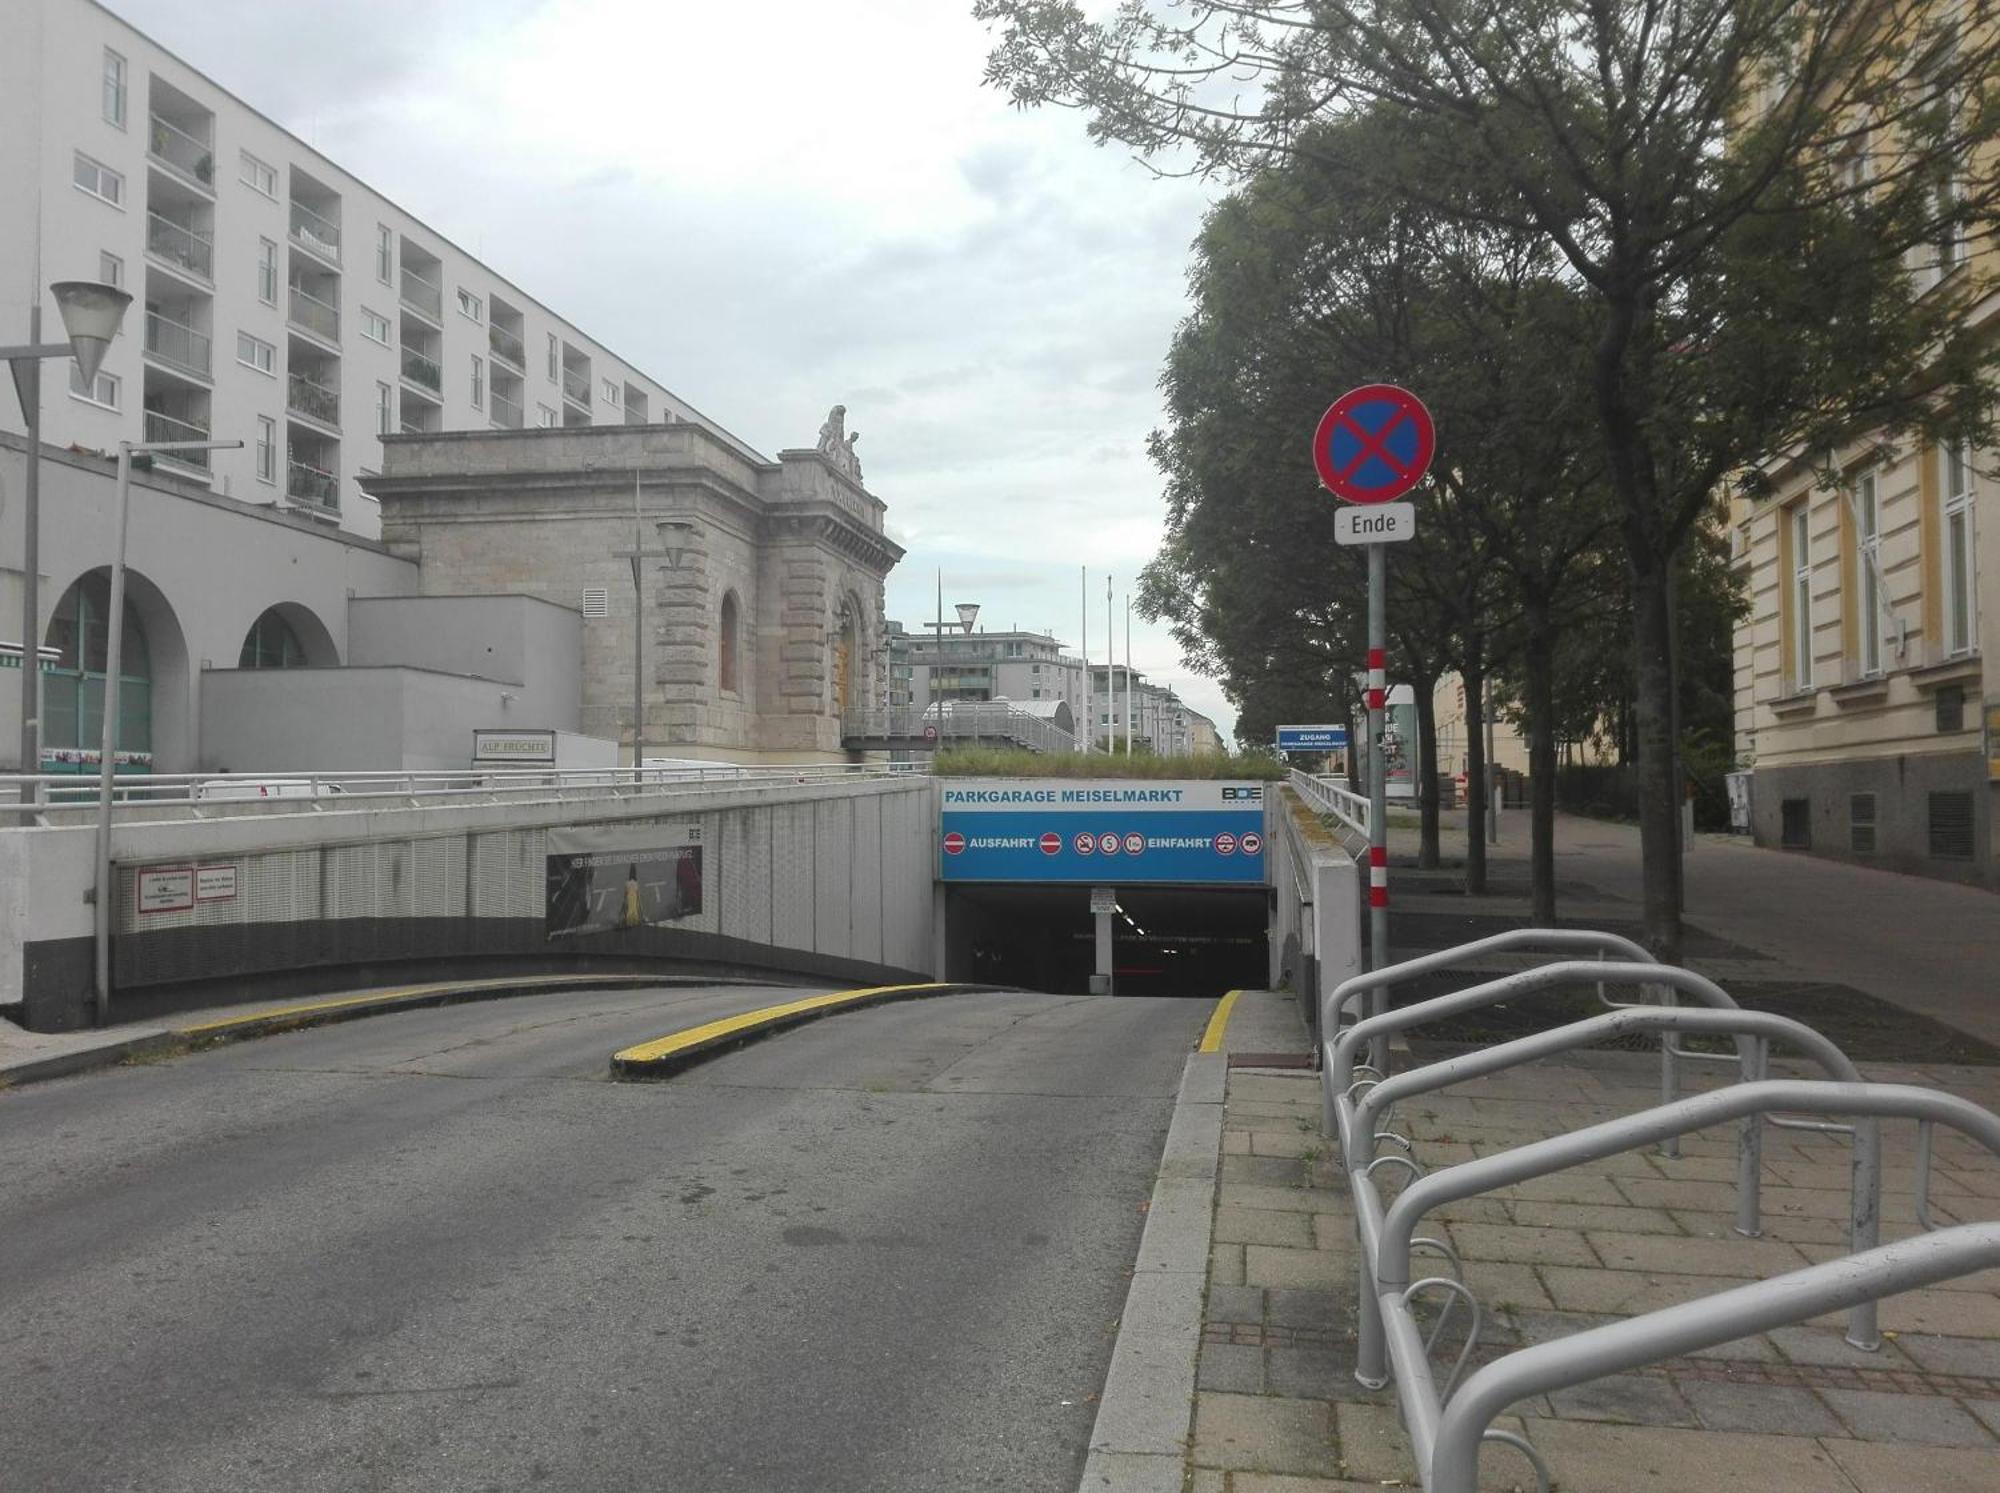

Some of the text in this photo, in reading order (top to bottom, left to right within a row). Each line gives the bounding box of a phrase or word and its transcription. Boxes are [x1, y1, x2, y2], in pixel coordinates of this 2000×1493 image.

[1352, 514, 1396, 534] Ende
[945, 790, 1183, 803] PARKGARAGE MEISELMARKT
[969, 838, 1036, 848] AUSFAHRT
[1148, 838, 1213, 848] EINFAHRT
